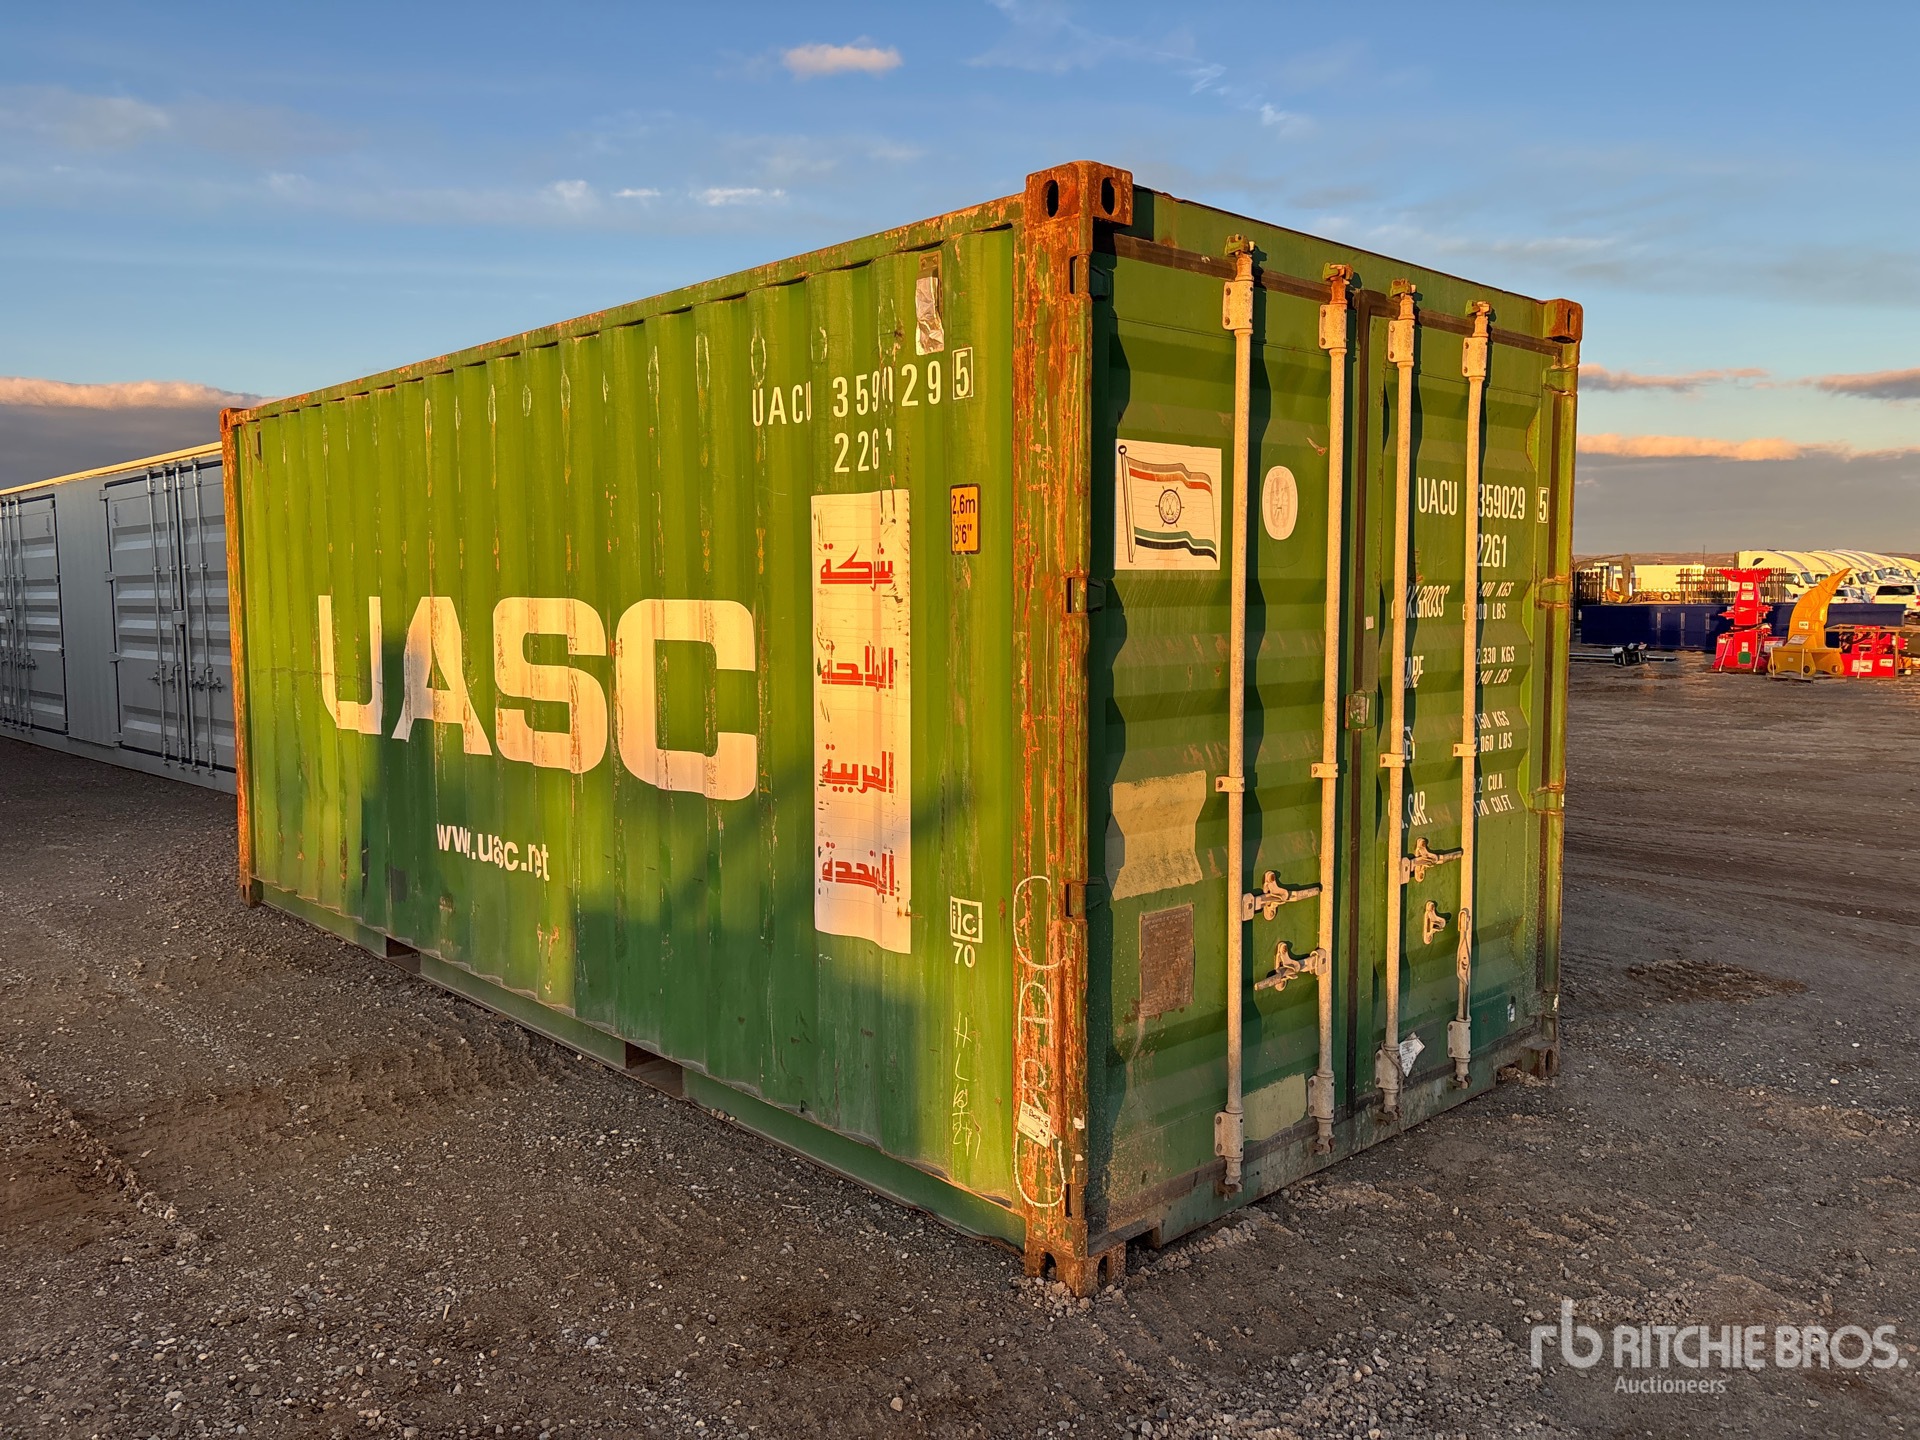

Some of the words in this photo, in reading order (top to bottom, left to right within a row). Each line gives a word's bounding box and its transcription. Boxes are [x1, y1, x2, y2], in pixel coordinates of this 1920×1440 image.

[752, 380, 812, 427] UACU
[954, 349, 972, 398] 5
[834, 427, 892, 473] 22G1
[1417, 477, 1458, 516] UACU
[1478, 483, 1526, 520] 359029
[1538, 488, 1548, 522] 5
[1477, 534, 1507, 568] 22G1
[1496, 581, 1514, 598] KGS
[1492, 602, 1506, 620] LBS
[1404, 655, 1424, 690] ARE
[1501, 645, 1515, 664] KGS
[1494, 668, 1512, 684] LBS
[318, 594, 757, 801] UASC
[1491, 710, 1510, 728] KGS
[1498, 732, 1513, 750] LBS
[820, 743, 895, 794] العربية
[952, 941, 976, 969] 70
